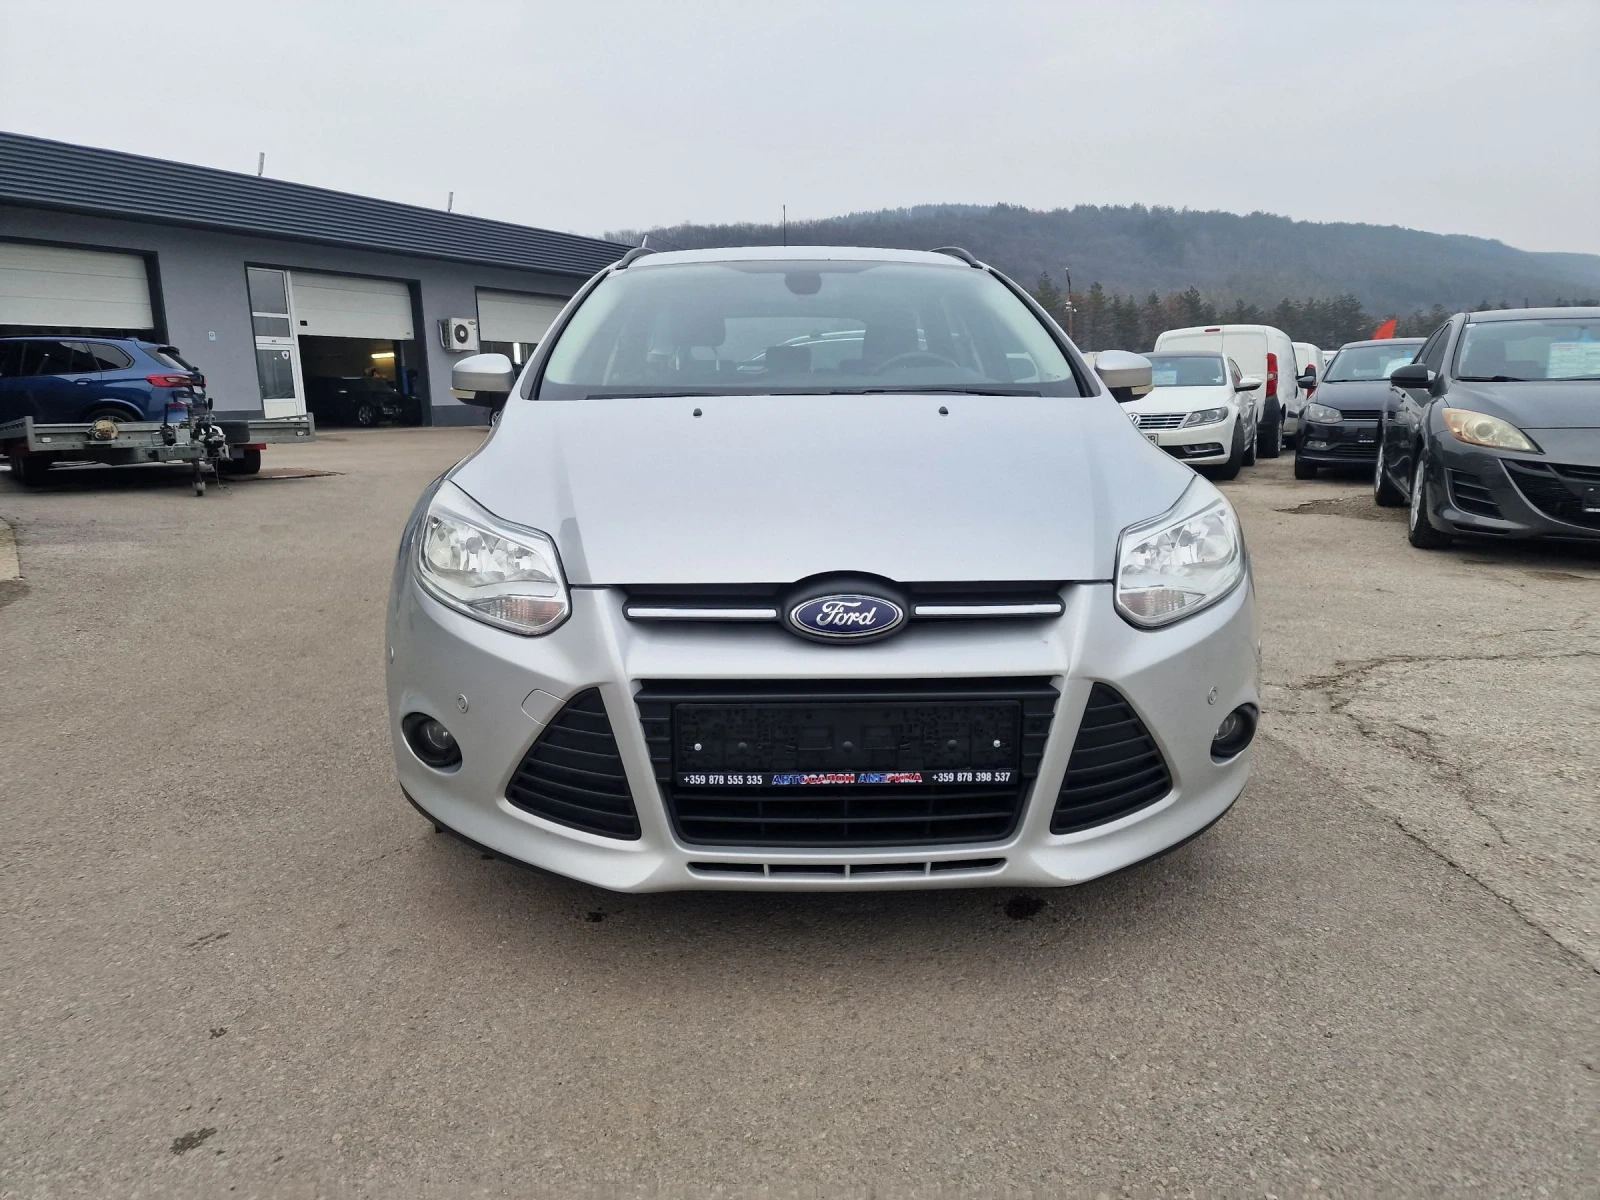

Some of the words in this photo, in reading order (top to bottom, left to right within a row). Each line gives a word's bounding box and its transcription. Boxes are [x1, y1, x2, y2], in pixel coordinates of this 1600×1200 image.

[816, 601, 877, 626] Ford
[683, 774, 706, 785] +359
[708, 774, 724, 785] 878
[727, 774, 743, 785] 555
[746, 775, 763, 785] 335
[772, 773, 855, 785] АВТОСАЛОН
[858, 772, 923, 784] АМЕРИКА
[932, 772, 954, 782] +359
[957, 772, 973, 782] 878
[975, 772, 992, 782] 398
[994, 772, 1011, 782] 537
